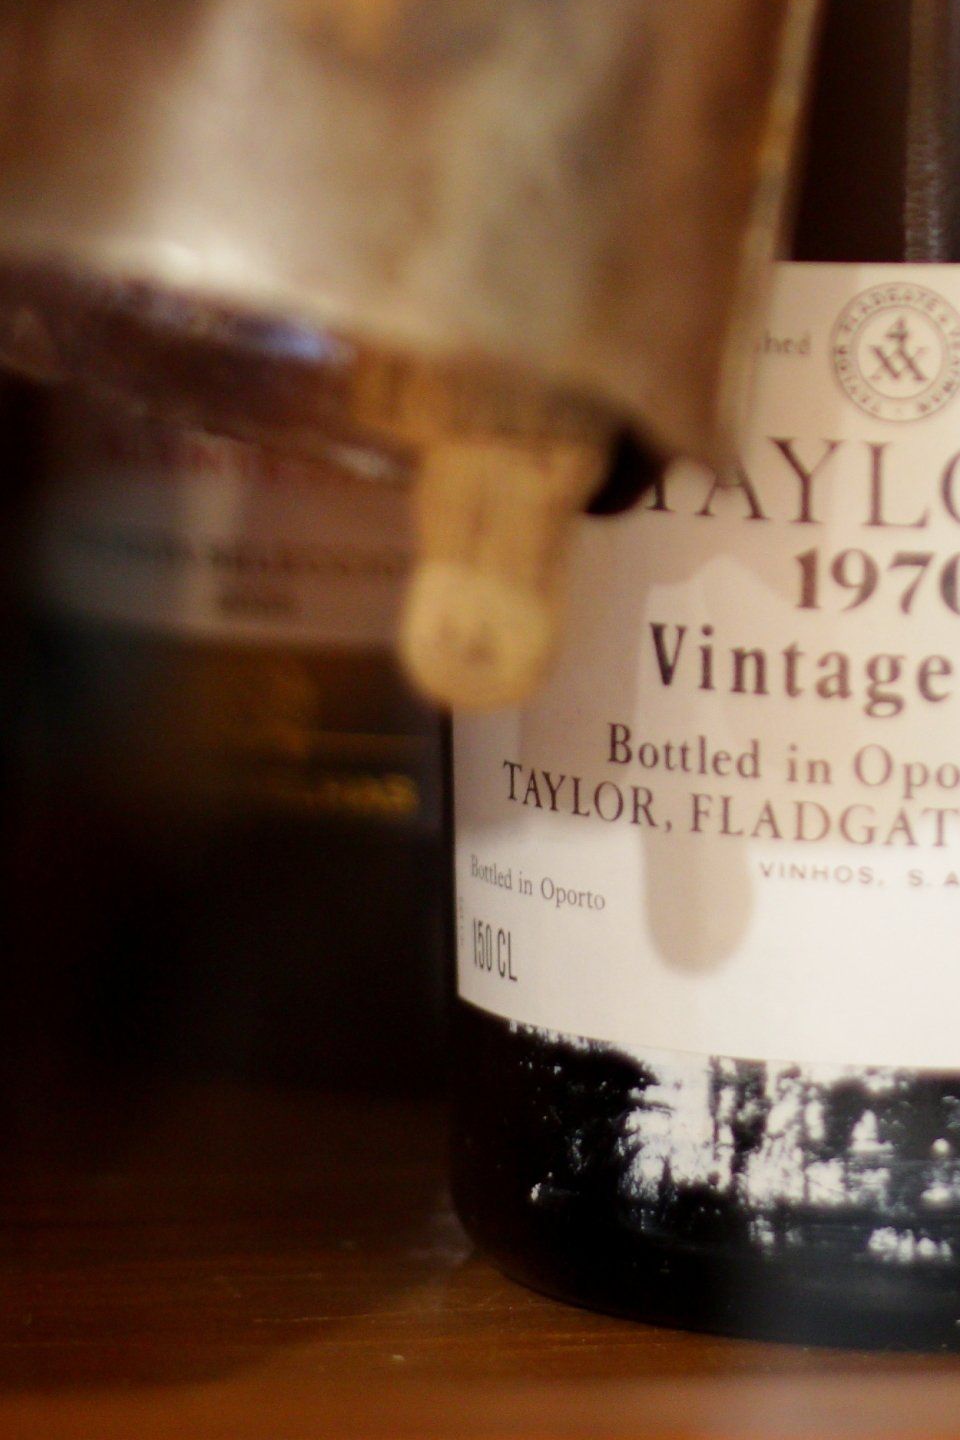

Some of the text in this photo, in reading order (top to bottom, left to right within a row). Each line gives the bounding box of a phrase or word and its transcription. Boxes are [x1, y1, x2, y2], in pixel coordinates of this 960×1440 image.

[648, 620, 955, 718] Vintage
[606, 721, 762, 780] Bottled
[785, 743, 833, 786] in
[502, 758, 676, 834] TAYLOR,
[469, 853, 608, 913] Bottled in Oporto
[472, 917, 494, 974] 150
[496, 926, 519, 983] CL
